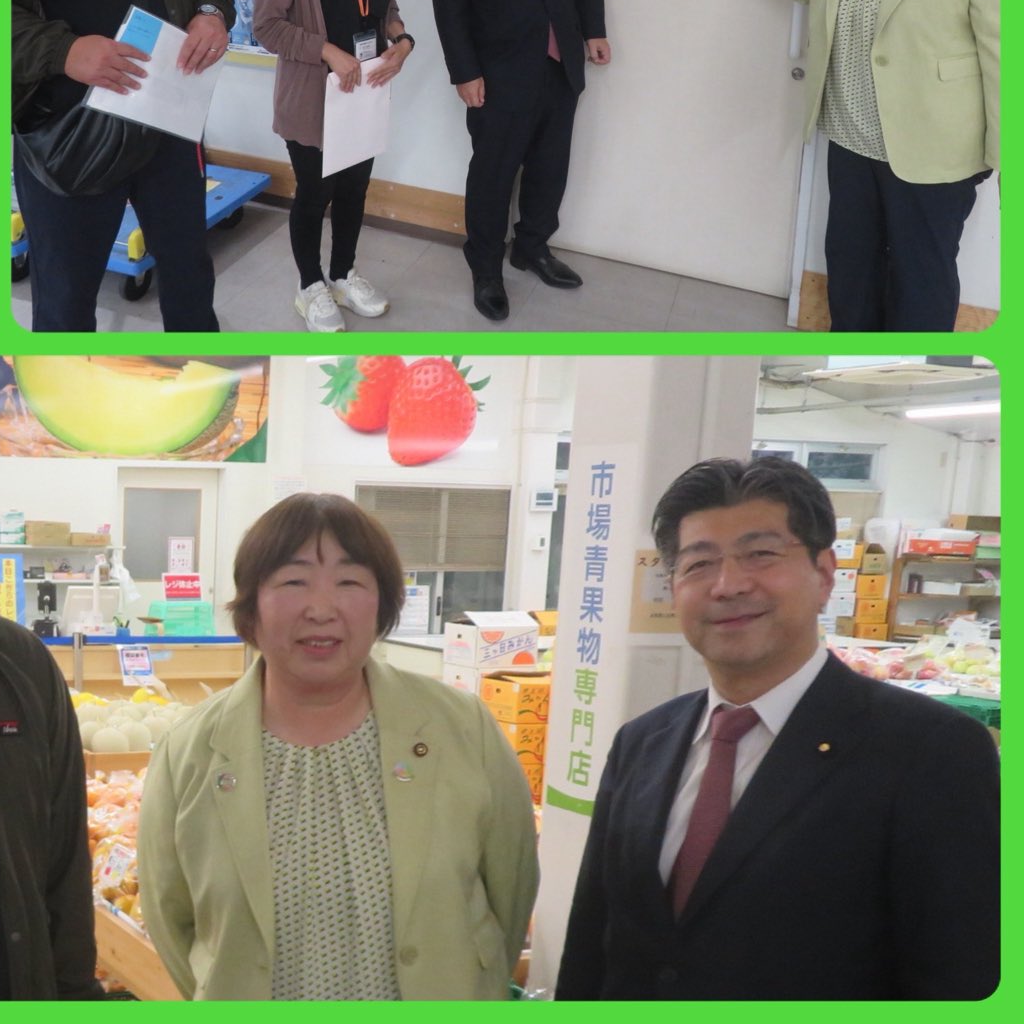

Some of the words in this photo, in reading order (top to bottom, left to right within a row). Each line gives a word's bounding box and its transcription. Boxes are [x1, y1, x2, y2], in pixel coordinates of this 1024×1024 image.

[566, 460, 616, 787] 市場青果物専門店
